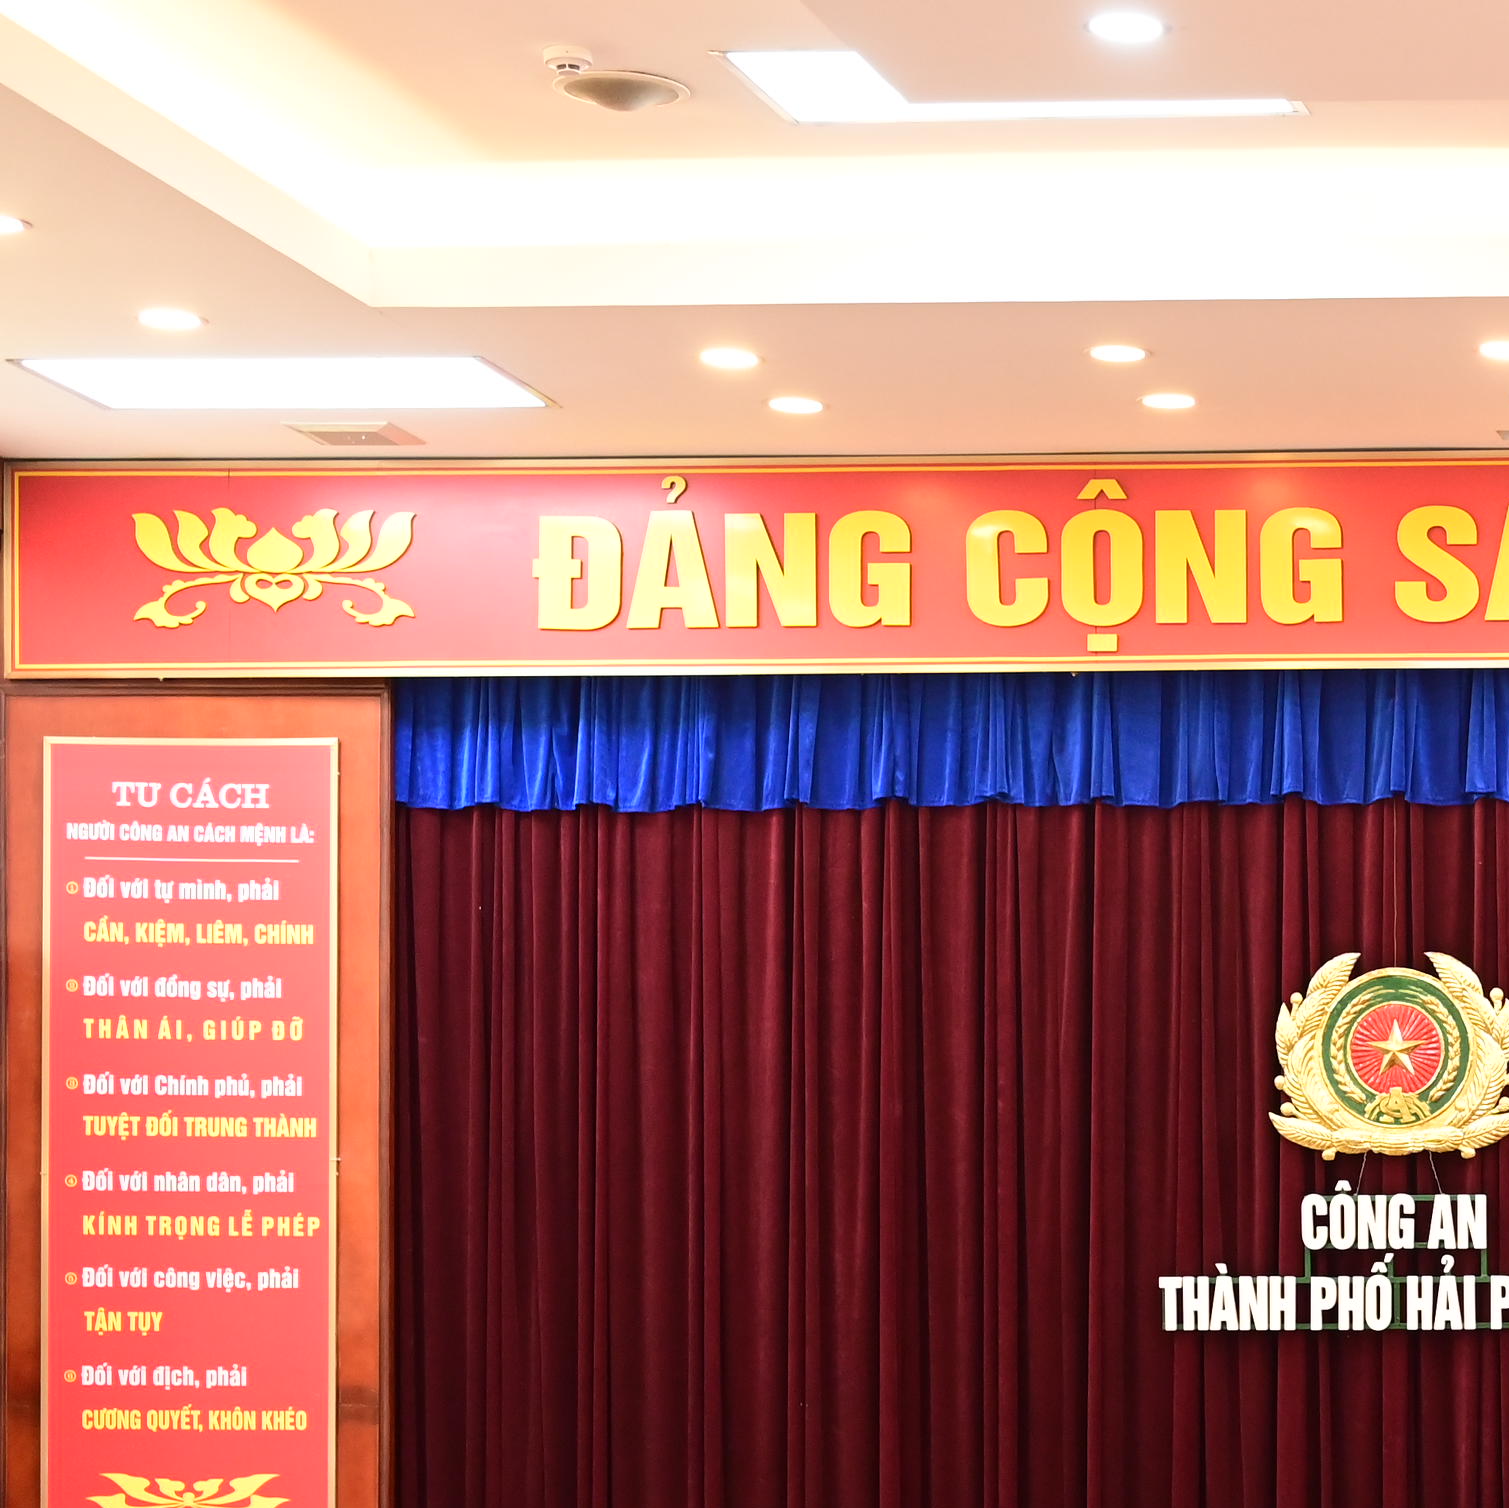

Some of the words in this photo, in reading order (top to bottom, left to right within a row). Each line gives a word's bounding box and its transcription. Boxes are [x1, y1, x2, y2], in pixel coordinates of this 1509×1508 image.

[533, 476, 913, 632] ĐẢNG
[966, 480, 1342, 651] CỘNG
[170, 778, 269, 808] CÁCH
[67, 820, 115, 840] NGƯỜI
[120, 821, 162, 841] CÔNG
[167, 825, 189, 842] AN
[194, 823, 235, 842] CÁCH
[291, 824, 314, 843] LÀ:
[83, 875, 114, 898] Đối
[120, 878, 148, 898] với
[154, 880, 174, 903] tự
[238, 878, 279, 902] phải
[83, 1112, 140, 1140] TUYỆT
[146, 1110, 178, 1136] ĐỐI
[184, 1117, 247, 1137] TRUNG
[253, 1114, 316, 1137] THÀNH
[83, 1211, 137, 1235] KÍNH
[146, 1216, 219, 1240] TRỌNG
[262, 1213, 320, 1236] PHÉP
[1301, 1180, 1415, 1250] CÔNG
[1427, 1194, 1487, 1249] AN
[1159, 1263, 1296, 1331] THÀNH
[1310, 1253, 1394, 1331] PHỐ
[1406, 1255, 1476, 1330] HẢI
[84, 1307, 121, 1335] TẬN
[128, 1312, 162, 1336] TỤY
[147, 1404, 203, 1432] QUYẾT,
[209, 1407, 256, 1430] KHÔN
[262, 1407, 307, 1430] KHÉO
